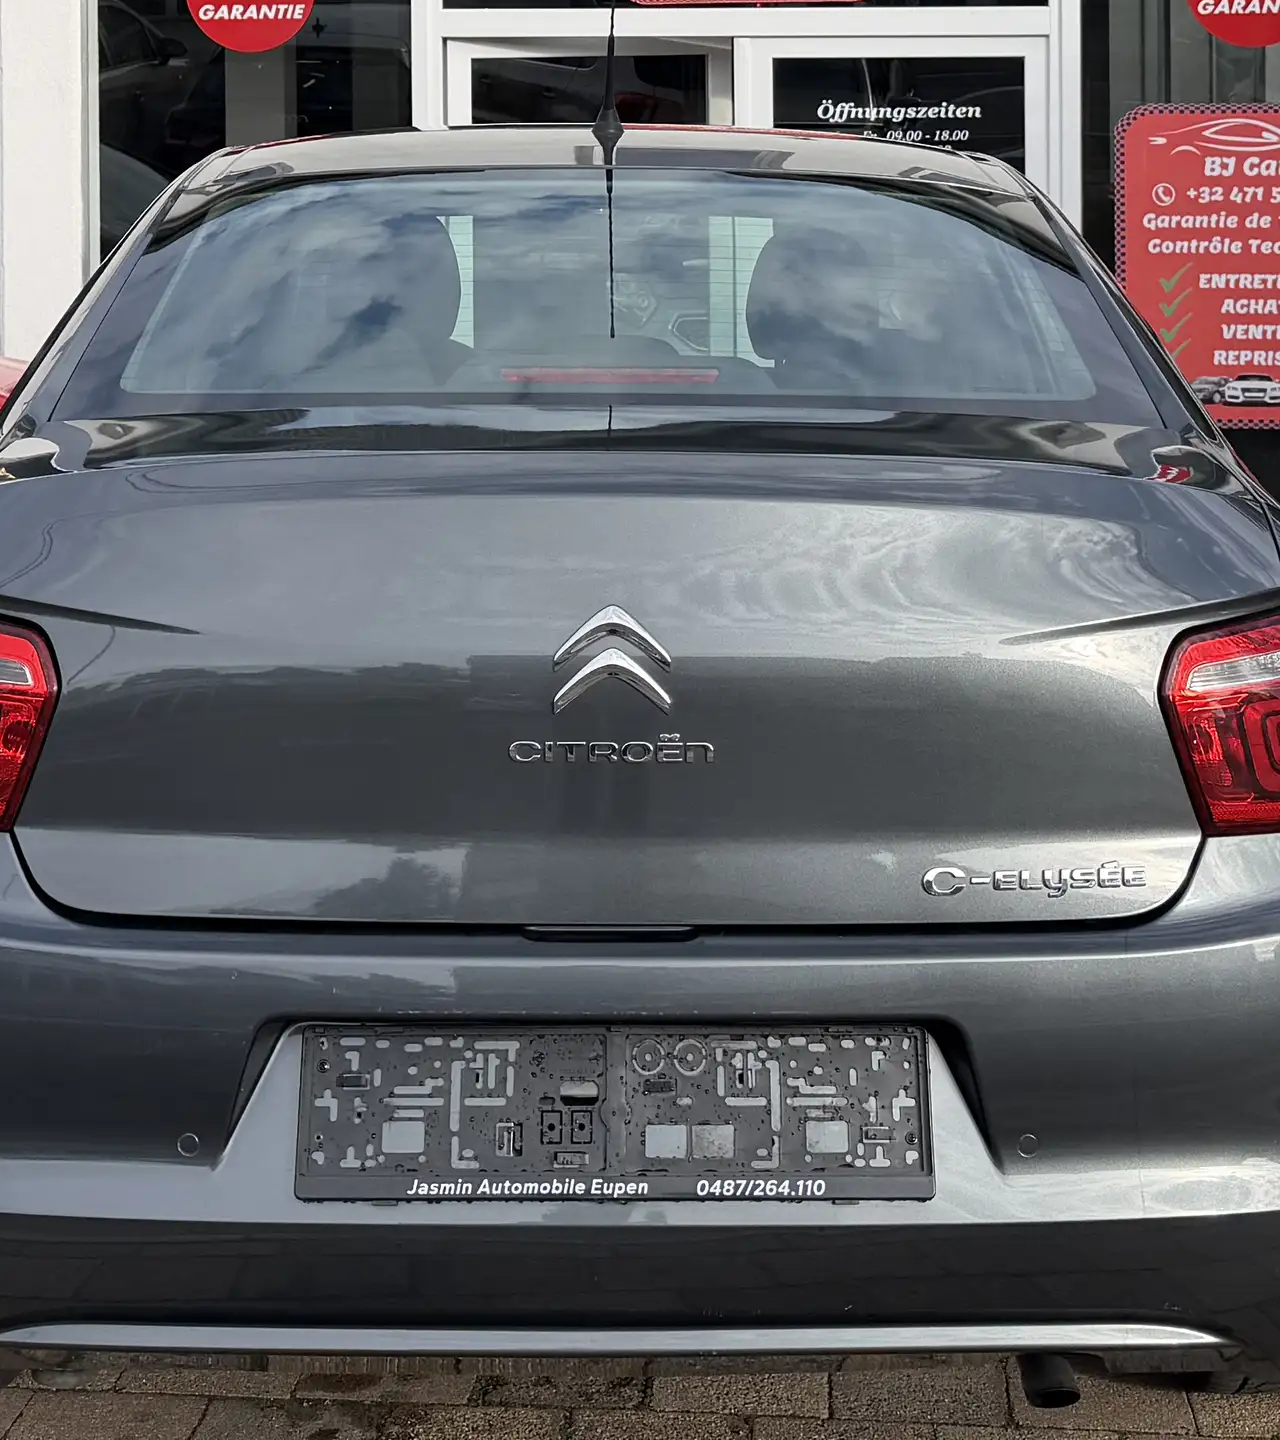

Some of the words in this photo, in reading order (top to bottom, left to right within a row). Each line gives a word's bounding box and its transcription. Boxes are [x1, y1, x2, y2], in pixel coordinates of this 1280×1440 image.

[198, 3, 306, 21] GARANTIE
[817, 99, 982, 123] Öffnungszeiten
[934, 129, 969, 141] 18.00
[1203, 156, 1236, 176] BJ
[1186, 186, 1224, 204] +32
[1229, 186, 1264, 204] 471
[1142, 211, 1239, 230] Garantie
[1244, 212, 1272, 229] de
[1147, 236, 1243, 255] Contrôle
[407, 1178, 473, 1196] Jasmin
[477, 1177, 586, 1196] Automobile
[590, 1178, 649, 1199] Eupen
[696, 1179, 826, 1196] 0487/264.110
